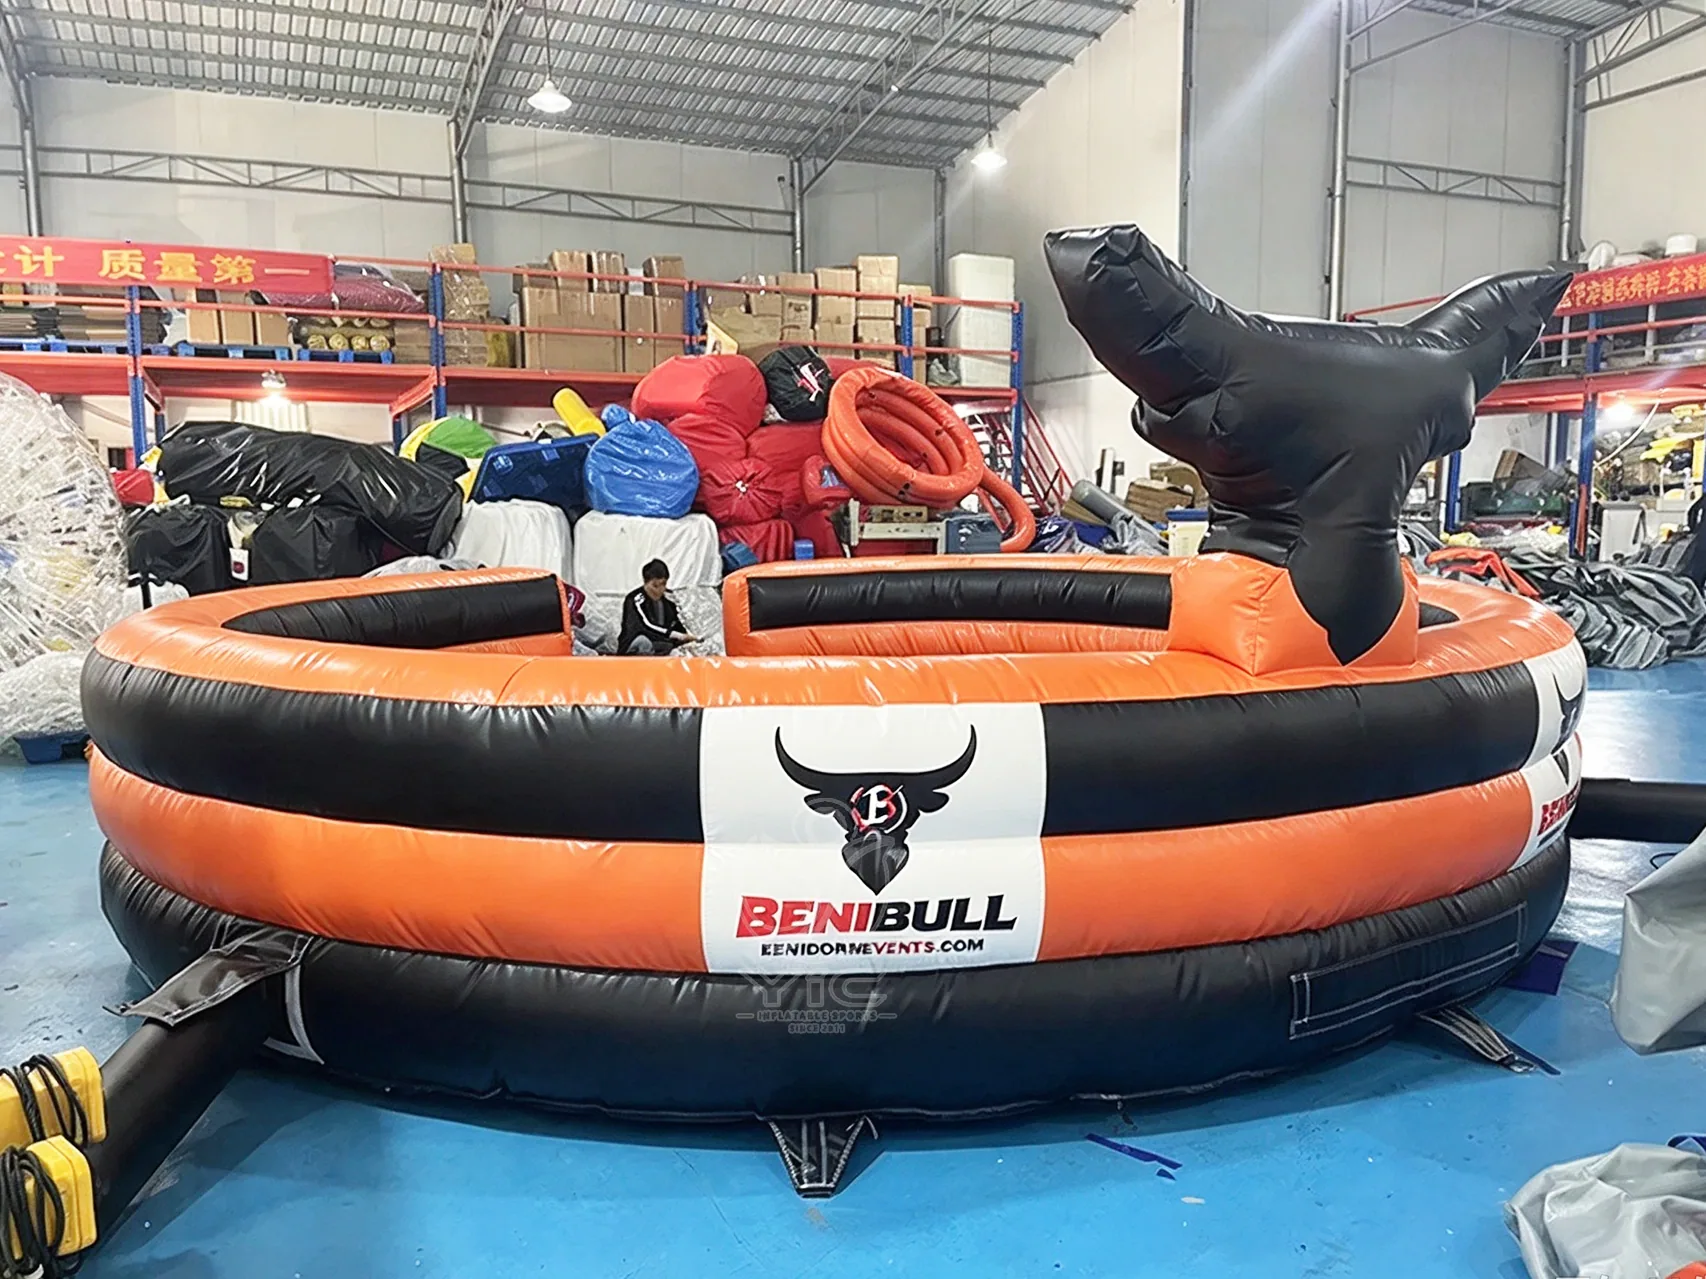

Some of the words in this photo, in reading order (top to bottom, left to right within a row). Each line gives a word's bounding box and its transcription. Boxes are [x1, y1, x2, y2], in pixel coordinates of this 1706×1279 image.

[0, 245, 65, 277] 计
[99, 249, 311, 284] 质量第一
[736, 894, 1018, 938] BENIBULL
